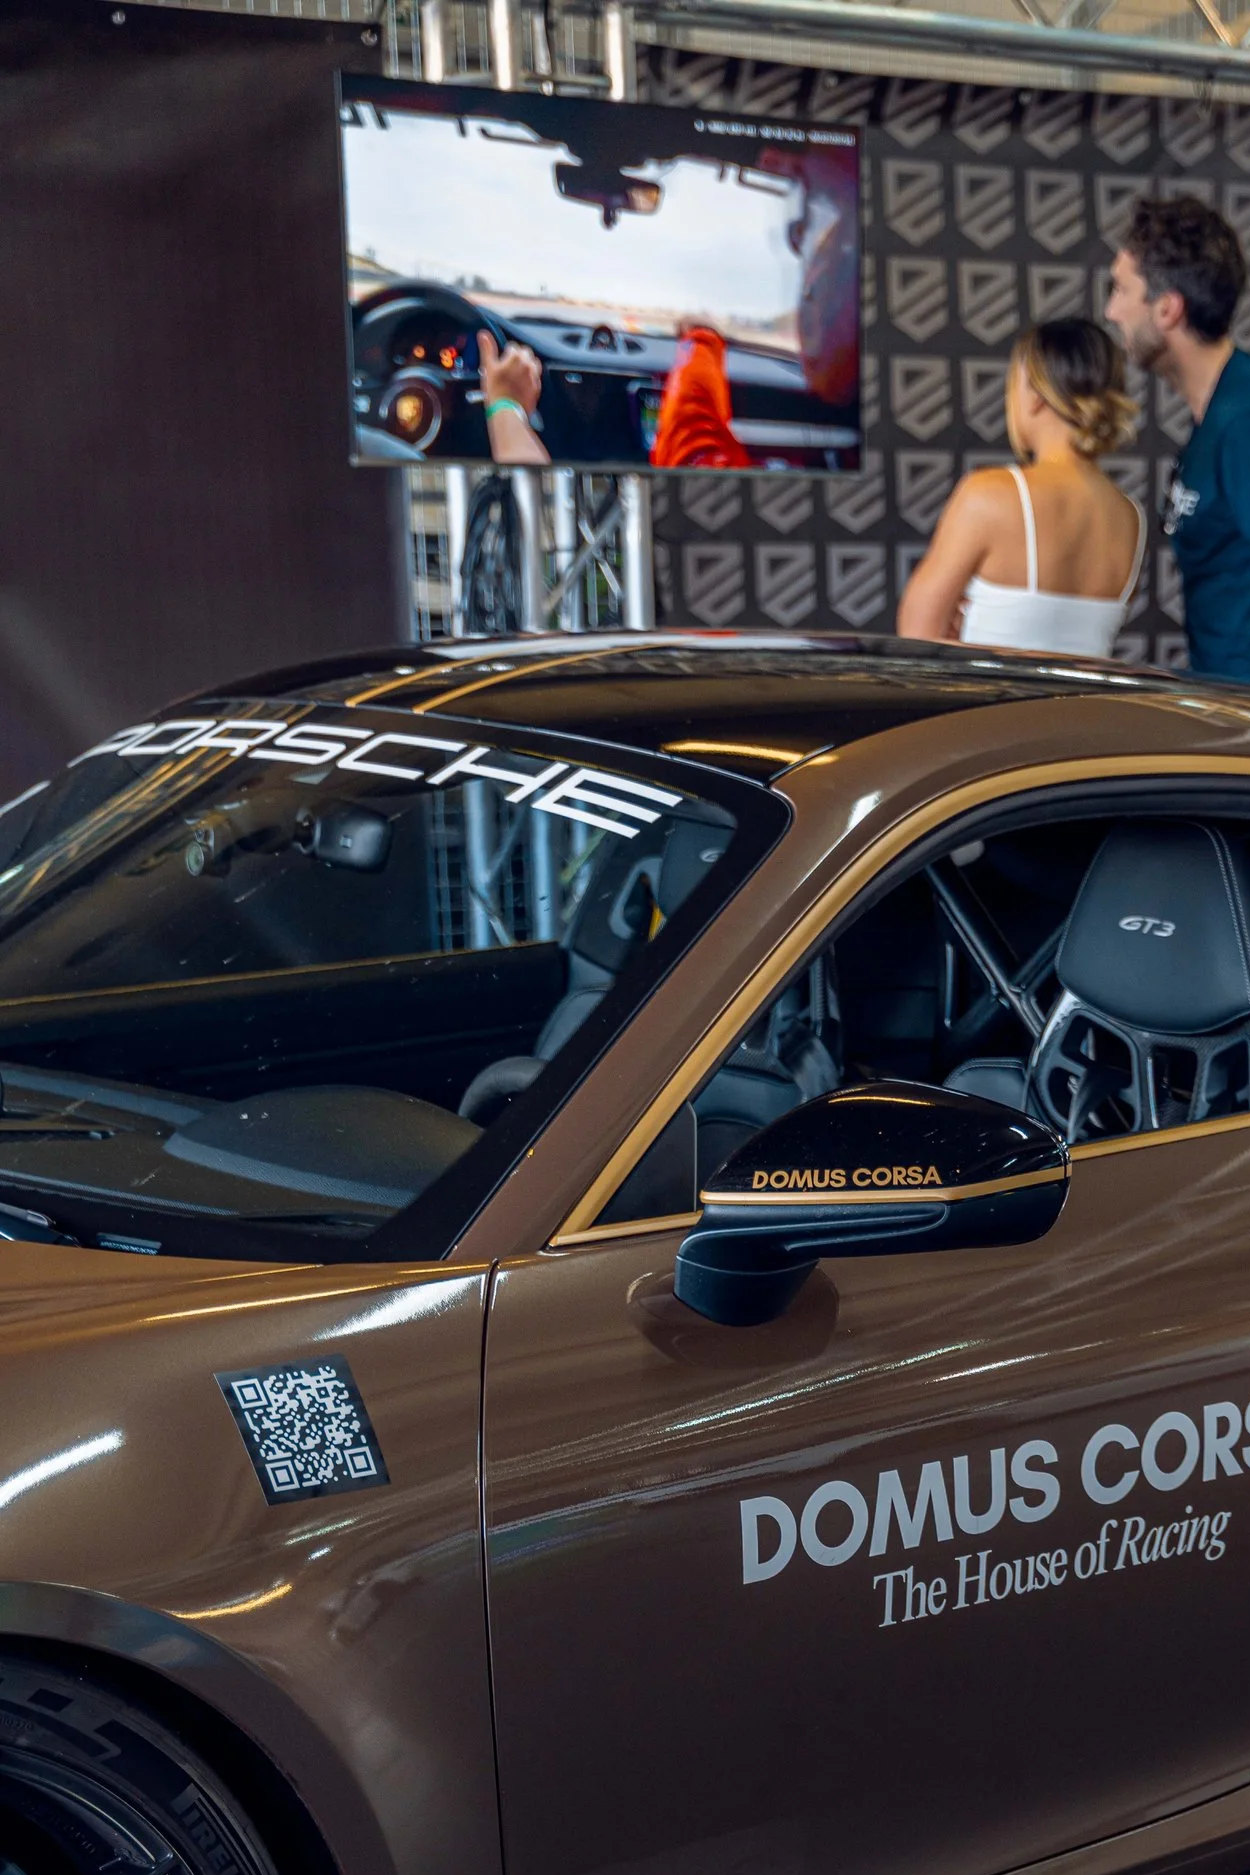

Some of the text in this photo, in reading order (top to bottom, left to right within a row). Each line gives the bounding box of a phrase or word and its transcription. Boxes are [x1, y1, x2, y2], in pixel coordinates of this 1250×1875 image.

[67, 720, 682, 839] PORSCHE
[1119, 915, 1176, 937] GT3
[752, 1166, 942, 1189] DOMUS CORSA
[740, 1440, 1060, 1585] DOMUS
[872, 1504, 1232, 1628] The House of Racing
